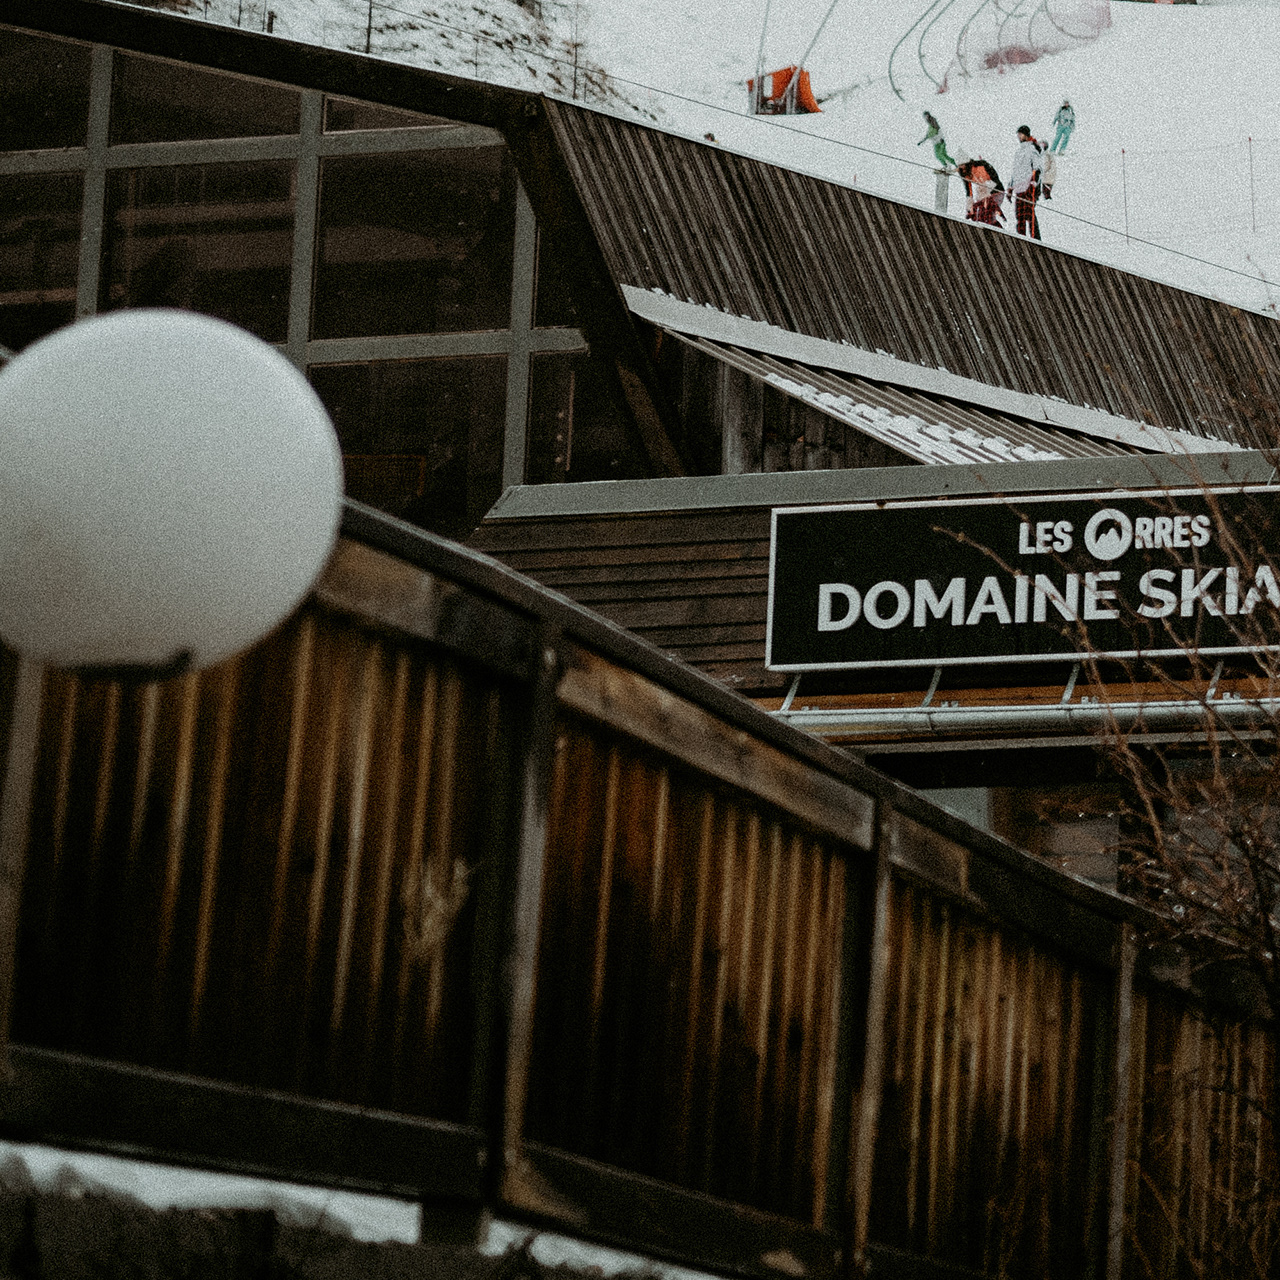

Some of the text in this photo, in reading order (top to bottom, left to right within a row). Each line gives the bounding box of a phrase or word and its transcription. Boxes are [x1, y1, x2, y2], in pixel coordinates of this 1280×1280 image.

[1019, 508, 1211, 560] LES ORRES
[817, 572, 1120, 632] DOMAINE
